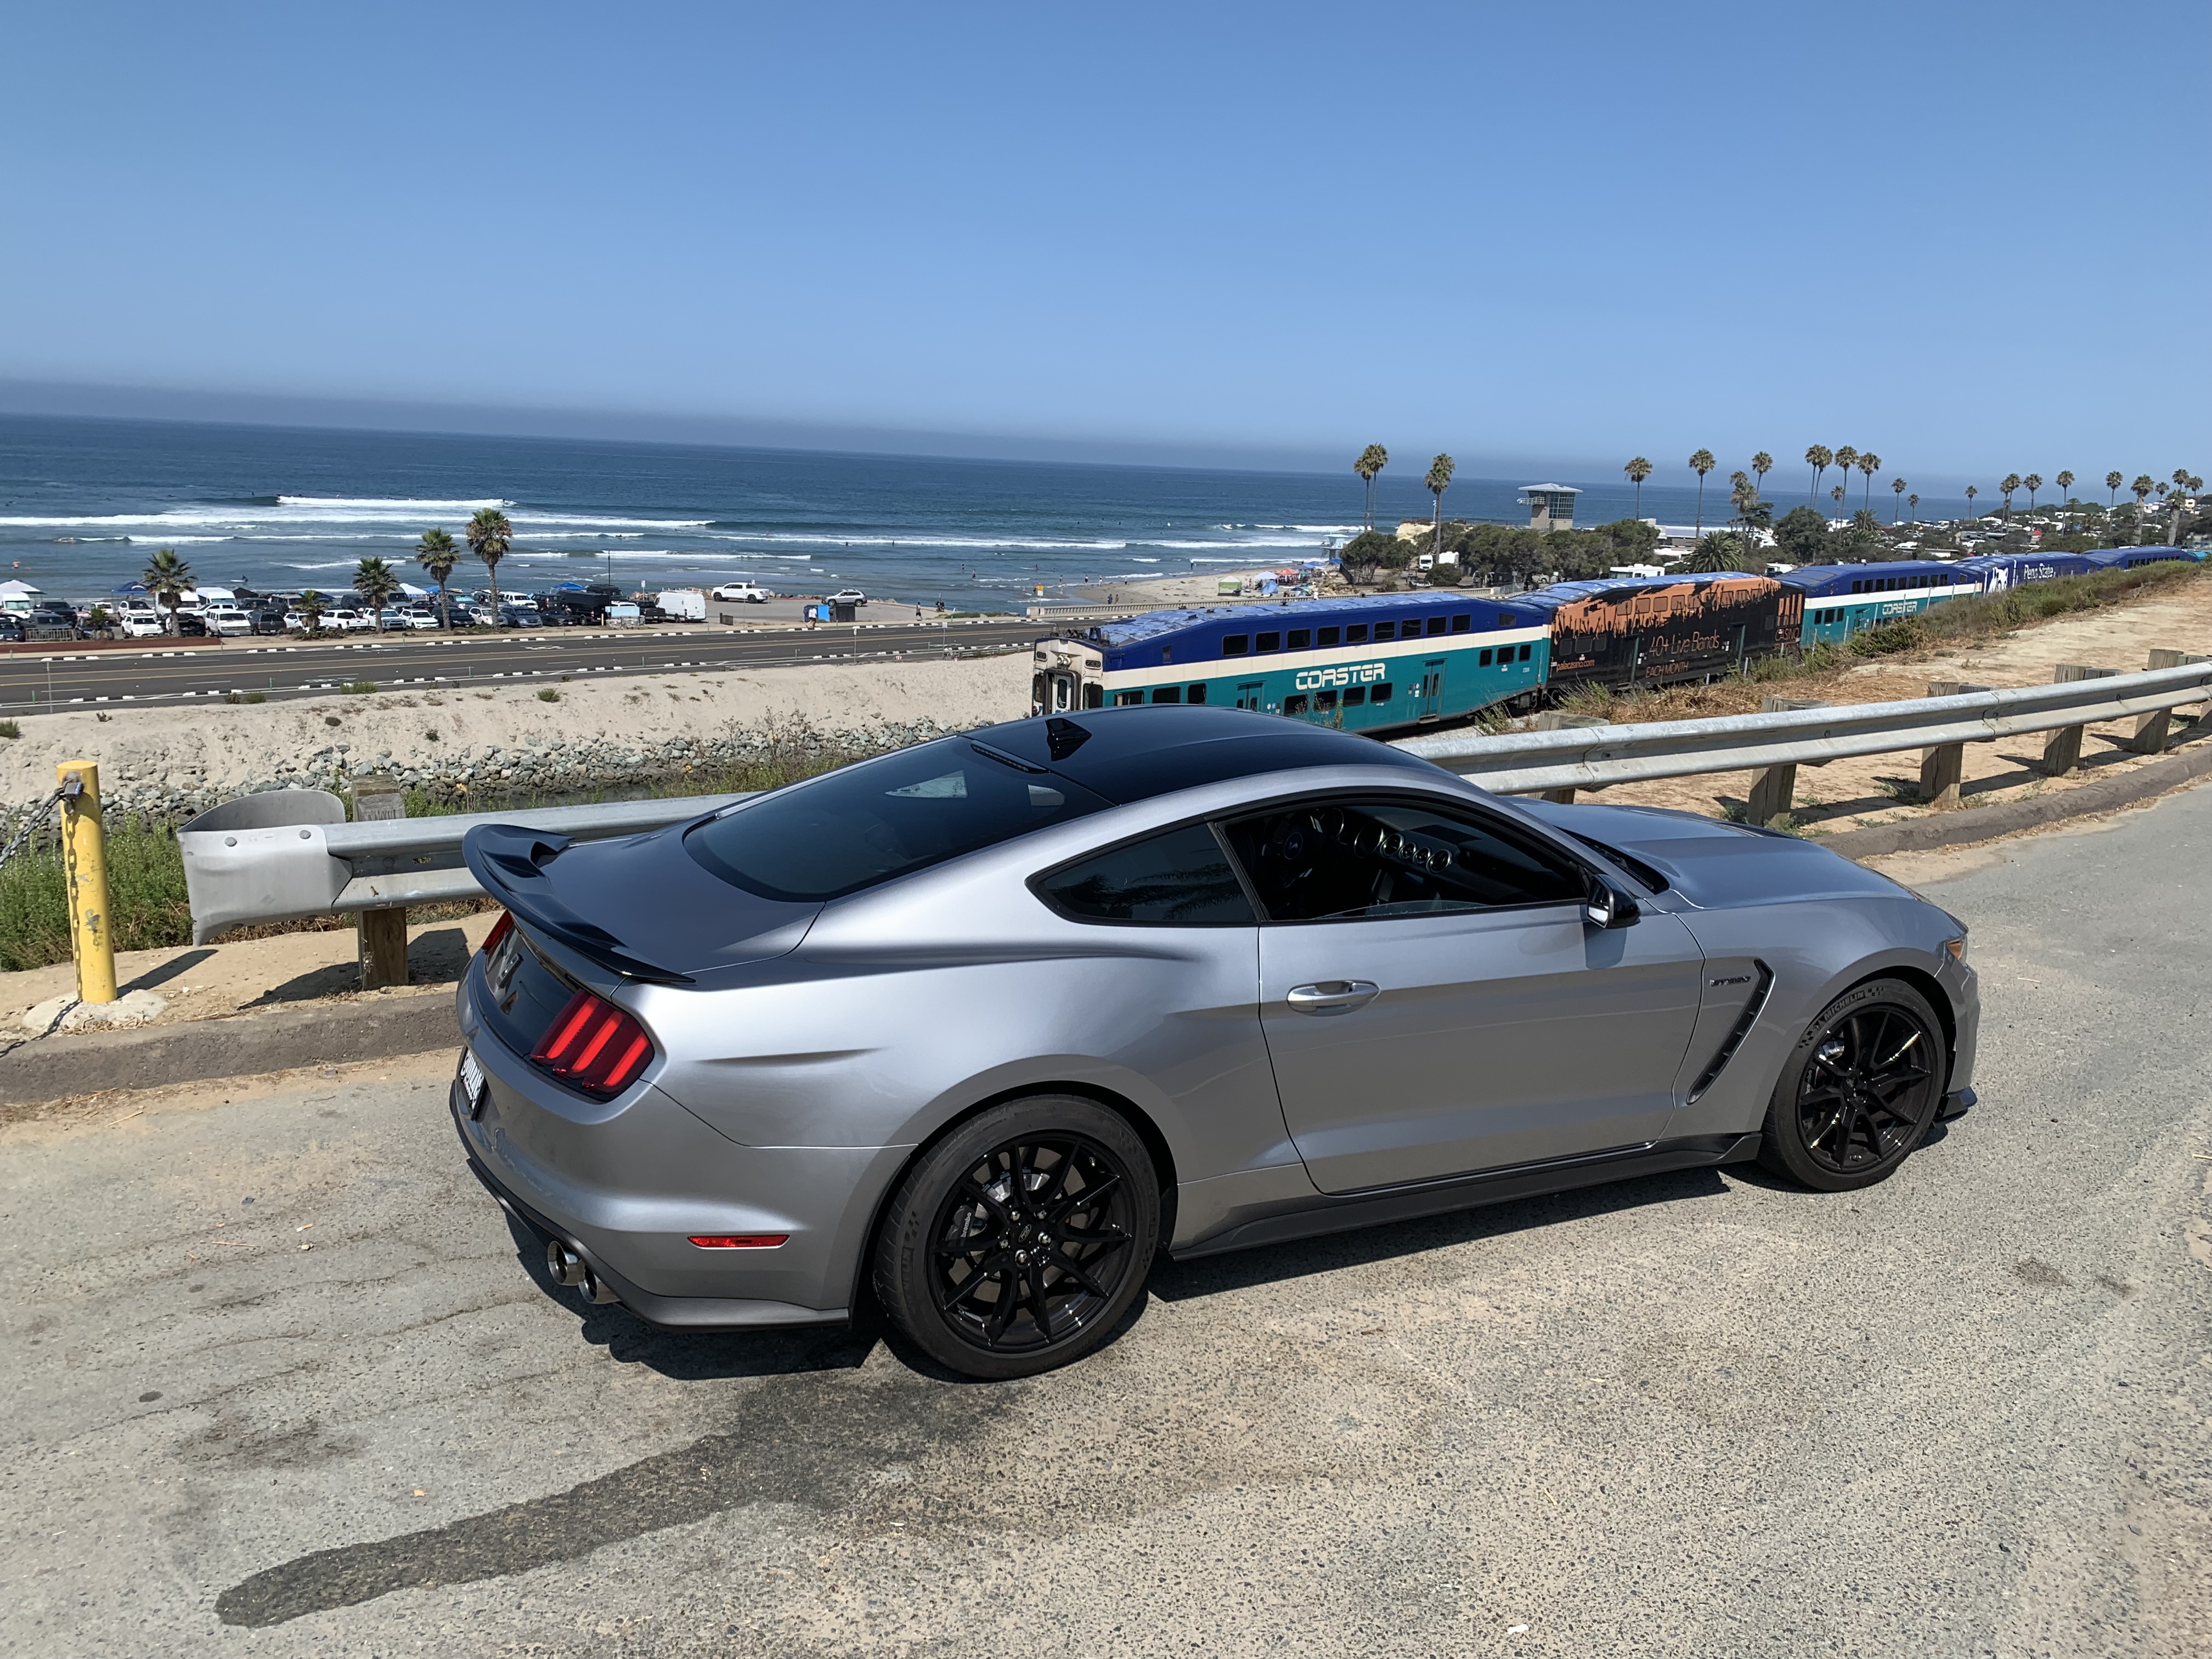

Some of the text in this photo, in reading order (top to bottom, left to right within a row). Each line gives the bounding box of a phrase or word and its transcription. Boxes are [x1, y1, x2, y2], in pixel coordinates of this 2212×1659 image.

[1882, 601, 1917, 616] COASTER
[1649, 629, 1720, 657] 40+ Live Bands
[1295, 662, 1386, 690] COASTER
[1646, 661, 1689, 678] EACH MONTH
[961, 1212, 972, 1238] brembo
